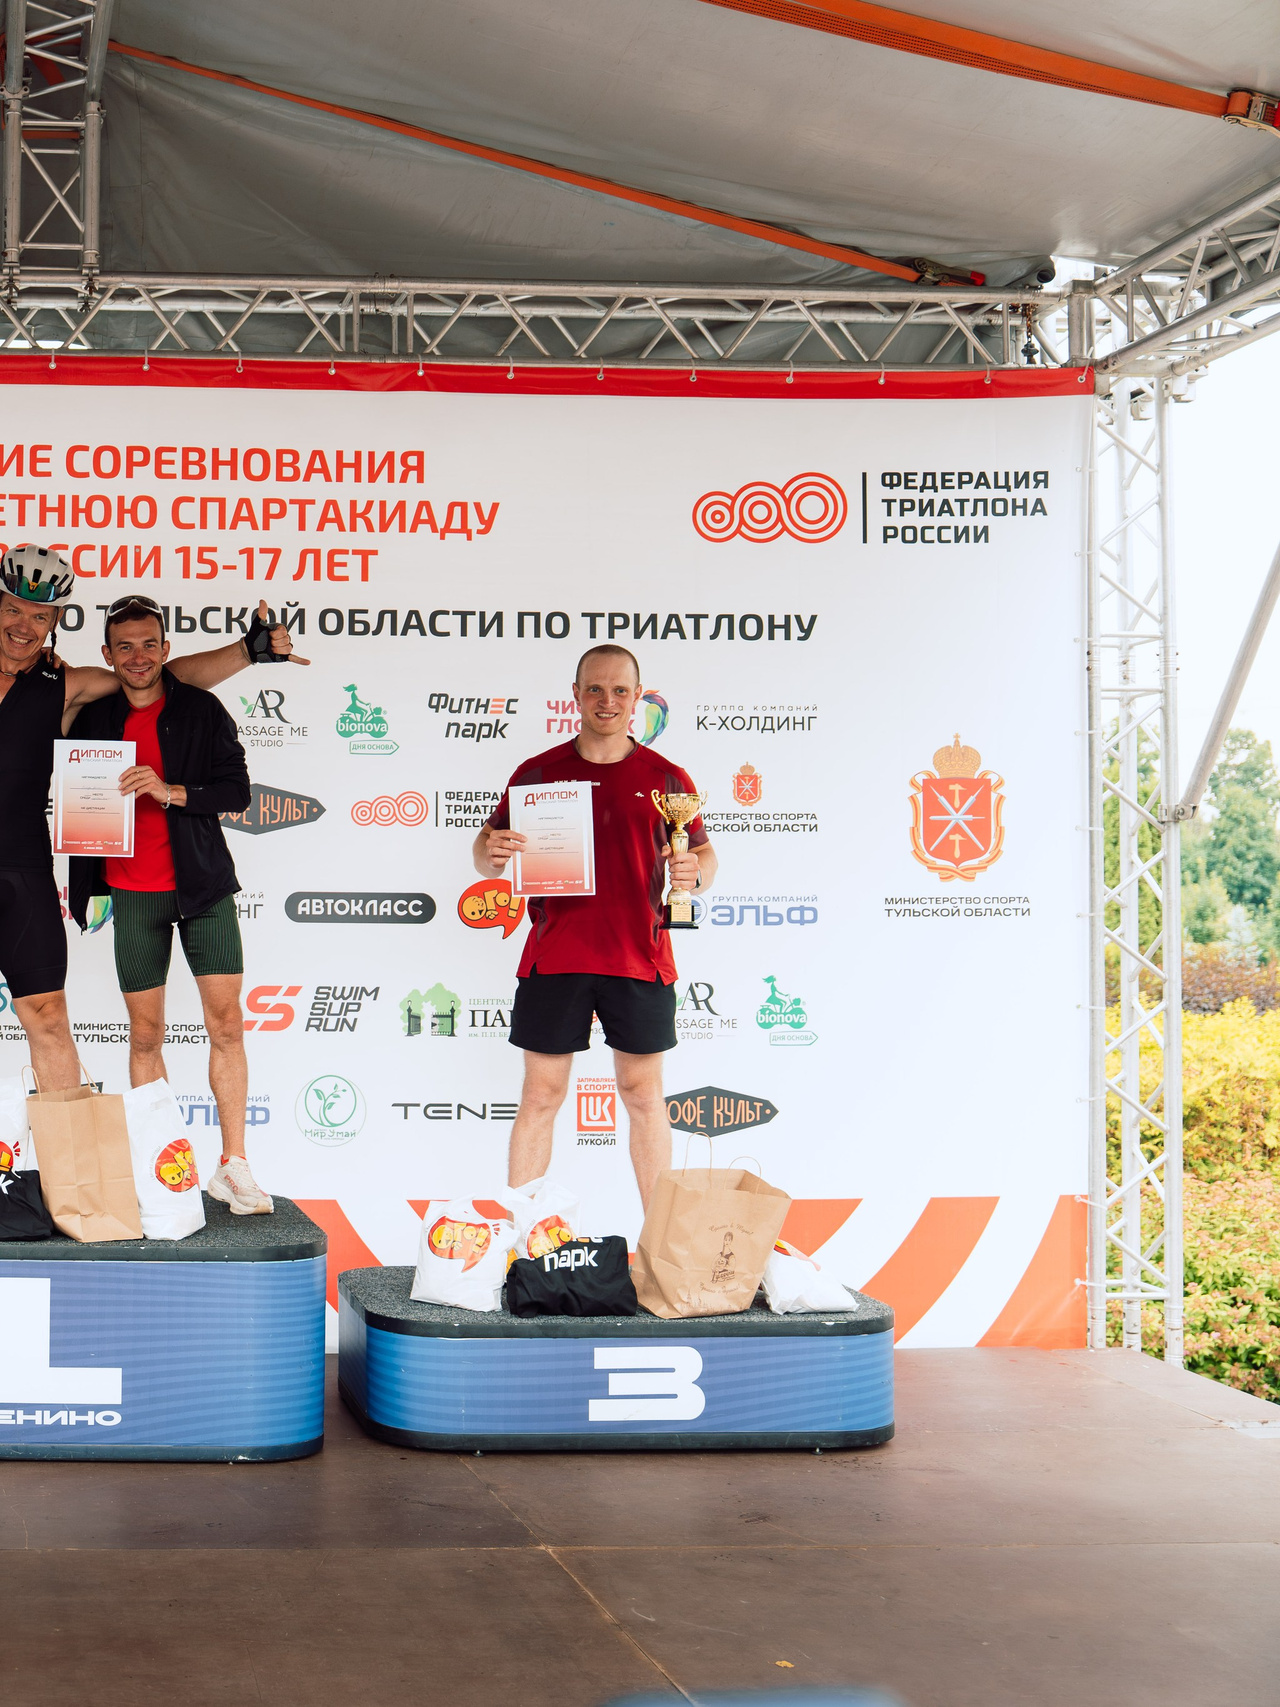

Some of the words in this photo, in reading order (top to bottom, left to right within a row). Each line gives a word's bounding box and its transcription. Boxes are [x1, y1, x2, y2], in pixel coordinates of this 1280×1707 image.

[64, 444, 426, 485] СОРЕВНОВАНИЯ
[880, 470, 1050, 493] ФЕДЕРАЦИЯ
[880, 497, 1049, 518] ТРИАТЛОНА
[170, 496, 500, 542] СПАРТАКИАДУ
[882, 524, 991, 545] РОССИИ
[173, 545, 282, 582] 15-17
[292, 547, 379, 583] ЛЕТ
[317, 607, 504, 639] ОБЛАСТИ
[516, 611, 571, 640] ПО
[581, 611, 819, 642] ТРИАТЛОНУ
[753, 703, 818, 712] компаний
[236, 725, 285, 738] ASSAGE
[289, 725, 309, 738] ME
[336, 718, 388, 735] bionova
[696, 715, 818, 734] К-ХОЛДИНГ
[250, 739, 284, 748] STUDIO
[351, 742, 366, 752] ДНЯ
[367, 743, 395, 752] ОСНОВА
[68, 748, 123, 764] ДИПЛОМ
[444, 791, 504, 803] ФЕДЕРА
[523, 790, 579, 807] ДИПЛОМ
[259, 793, 311, 826] КУЛЬТ
[444, 804, 498, 815] ТРИАТЛ
[700, 812, 771, 821] ИСТЕРСТВО
[772, 812, 818, 821] СПОРТА
[704, 821, 751, 833] ЬСКОЙ
[753, 823, 819, 833] ОБЛАСТИ
[712, 895, 755, 903] ГРУППА
[756, 894, 818, 903] КОМПАНИЙ
[883, 896, 982, 906] МИНИСТЕРСТВО
[982, 896, 1031, 905] СПОРТА
[297, 898, 424, 917] АВТОКЛАСС
[711, 903, 819, 927] ЭЛЬФ
[884, 905, 961, 918] ТУЛЬСКОЙ
[963, 907, 1032, 918] ОБЛАСТИ
[313, 985, 381, 1002] SWIM
[308, 1001, 362, 1017] SUP
[304, 1017, 358, 1033] RUN
[675, 1018, 714, 1029] SSAGE
[720, 1018, 738, 1029] ME
[756, 1010, 808, 1026] bionova
[171, 1023, 206, 1032] СПОР
[680, 1031, 714, 1040] STUDIO
[73, 1033, 131, 1044] ТУЛЬСК
[771, 1033, 785, 1043] ДНЯ
[786, 1034, 814, 1043] ОСНОВА
[666, 1095, 707, 1129] ОФЕ
[713, 1095, 764, 1129] КУЛЬТ
[304, 1128, 327, 1140] Мир
[327, 1128, 357, 1138] Умай
[576, 1136, 617, 1146] ЛУКОЙЛ
[587, 1345, 707, 1422] 3
